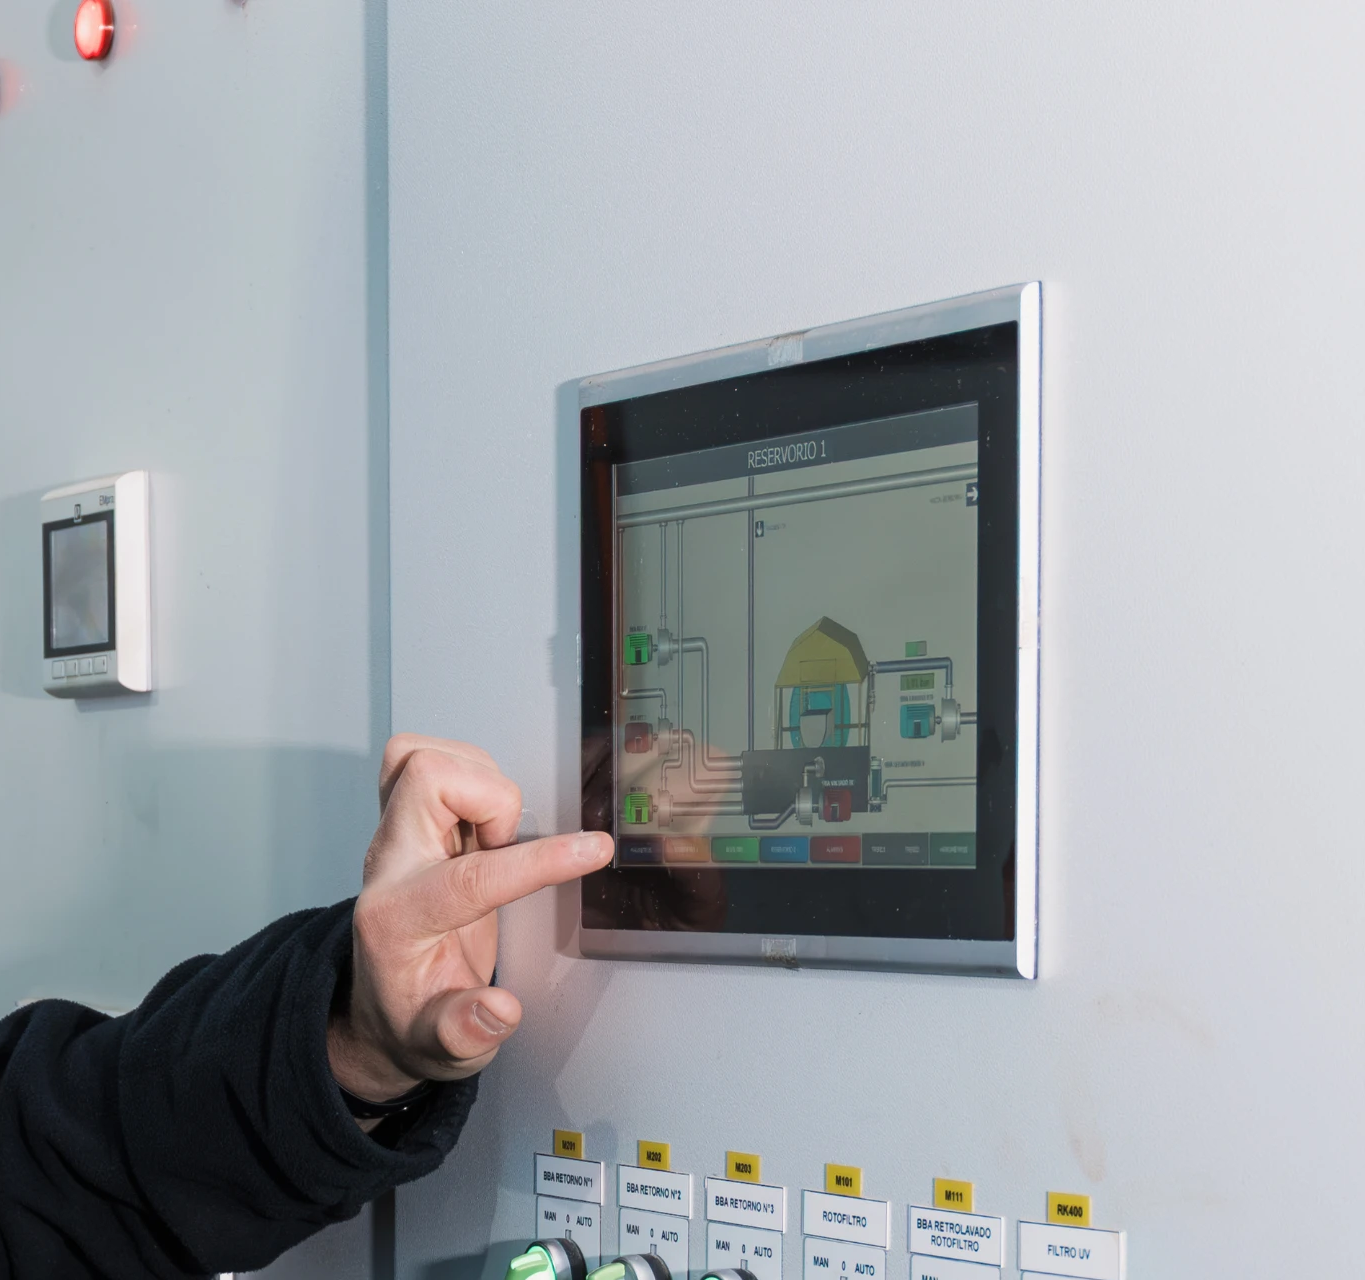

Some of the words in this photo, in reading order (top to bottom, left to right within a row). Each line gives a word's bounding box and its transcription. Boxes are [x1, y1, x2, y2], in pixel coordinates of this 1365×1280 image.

[748, 441, 817, 469] RESERVORIO
[820, 439, 826, 458] 1
[646, 1151, 661, 1162] M202
[735, 1162, 751, 1174] M203
[543, 1171, 557, 1181] BBA
[557, 1173, 582, 1187] RETORNO
[835, 1175, 852, 1187] M101
[626, 1182, 639, 1193] BBA
[640, 1184, 669, 1198] RETORNO
[945, 1190, 963, 1202] M111
[715, 1196, 729, 1207] BBA
[729, 1197, 761, 1211] RETORNO
[1057, 1204, 1082, 1217] RK400
[544, 1211, 556, 1222] MAN
[576, 1216, 592, 1227] AUTO
[822, 1211, 867, 1228] ROTOFILTRO
[626, 1224, 639, 1235] MAN
[661, 1231, 679, 1243] AUTO
[917, 1218, 933, 1231] BBA
[934, 1220, 991, 1239] RETROLAVADO
[715, 1240, 730, 1251] MAN
[754, 1247, 772, 1258] AUTO
[931, 1235, 979, 1252] ROTOFILTRO
[1047, 1244, 1076, 1259] FILTRO
[1079, 1249, 1091, 1260] UV
[813, 1256, 829, 1268] MAN
[855, 1263, 875, 1276] AUTO
